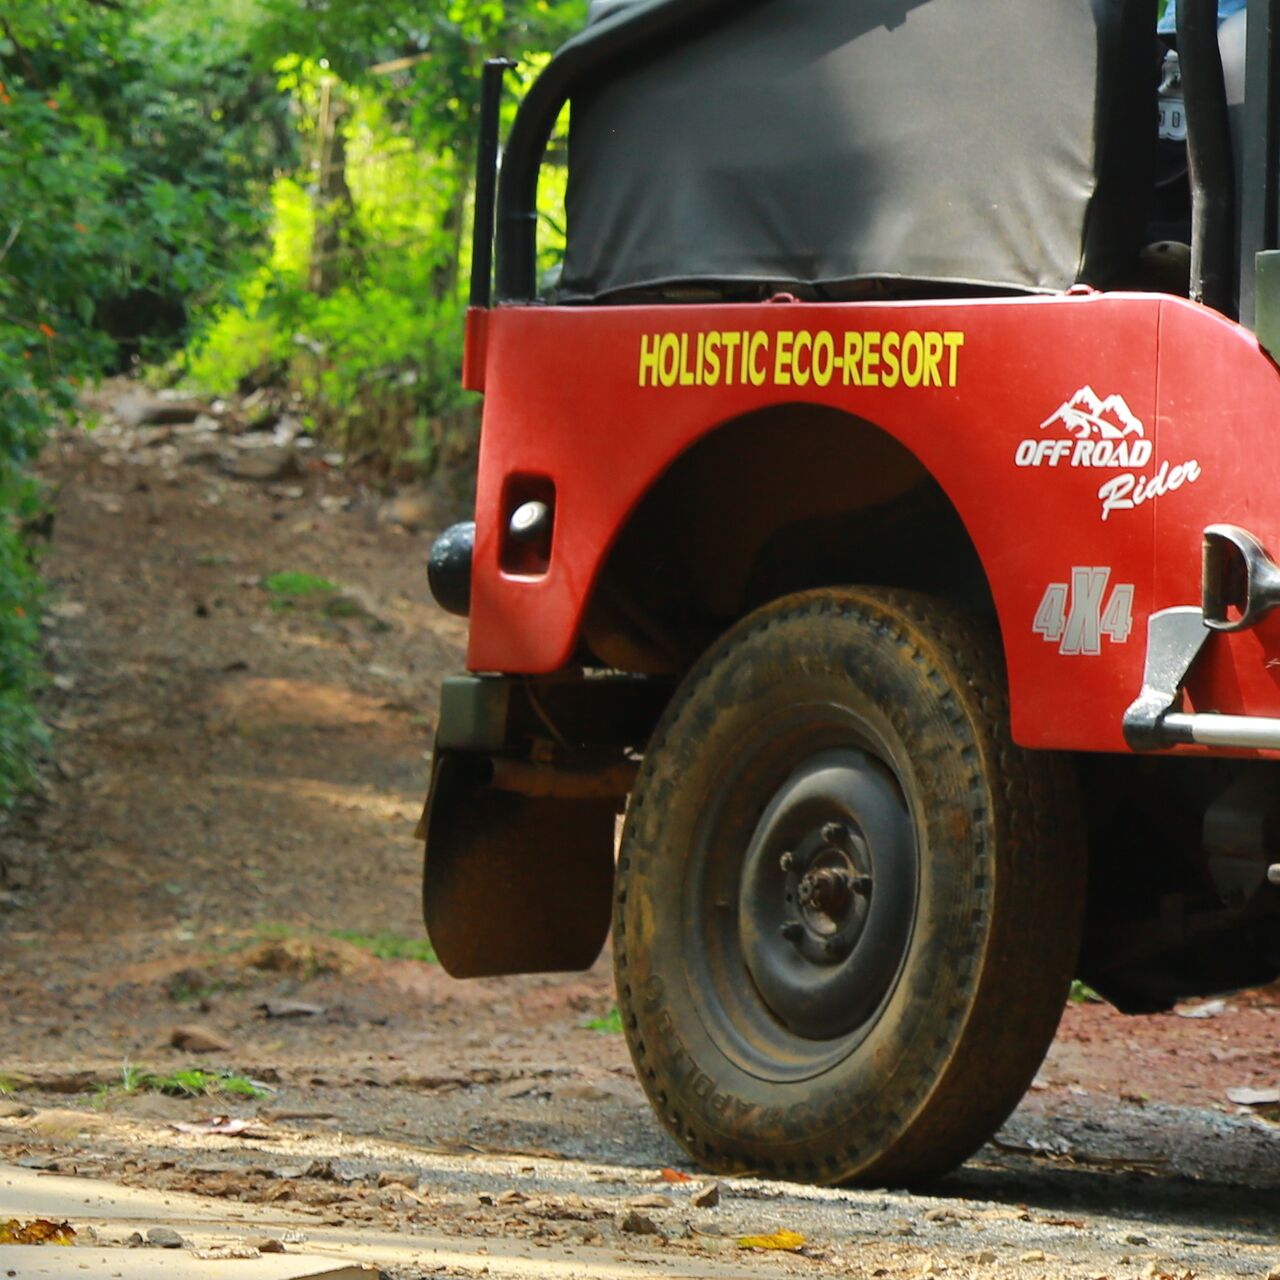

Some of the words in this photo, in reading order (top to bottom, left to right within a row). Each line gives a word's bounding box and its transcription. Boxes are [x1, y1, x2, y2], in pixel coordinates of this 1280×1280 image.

[637, 331, 769, 387] HOLISTIC
[773, 330, 965, 387] ECO-RESORT
[1014, 438, 1072, 468] OFF
[1071, 438, 1153, 468] ROAD
[1098, 459, 1202, 520] Rider
[1032, 566, 1135, 656] 4X4
